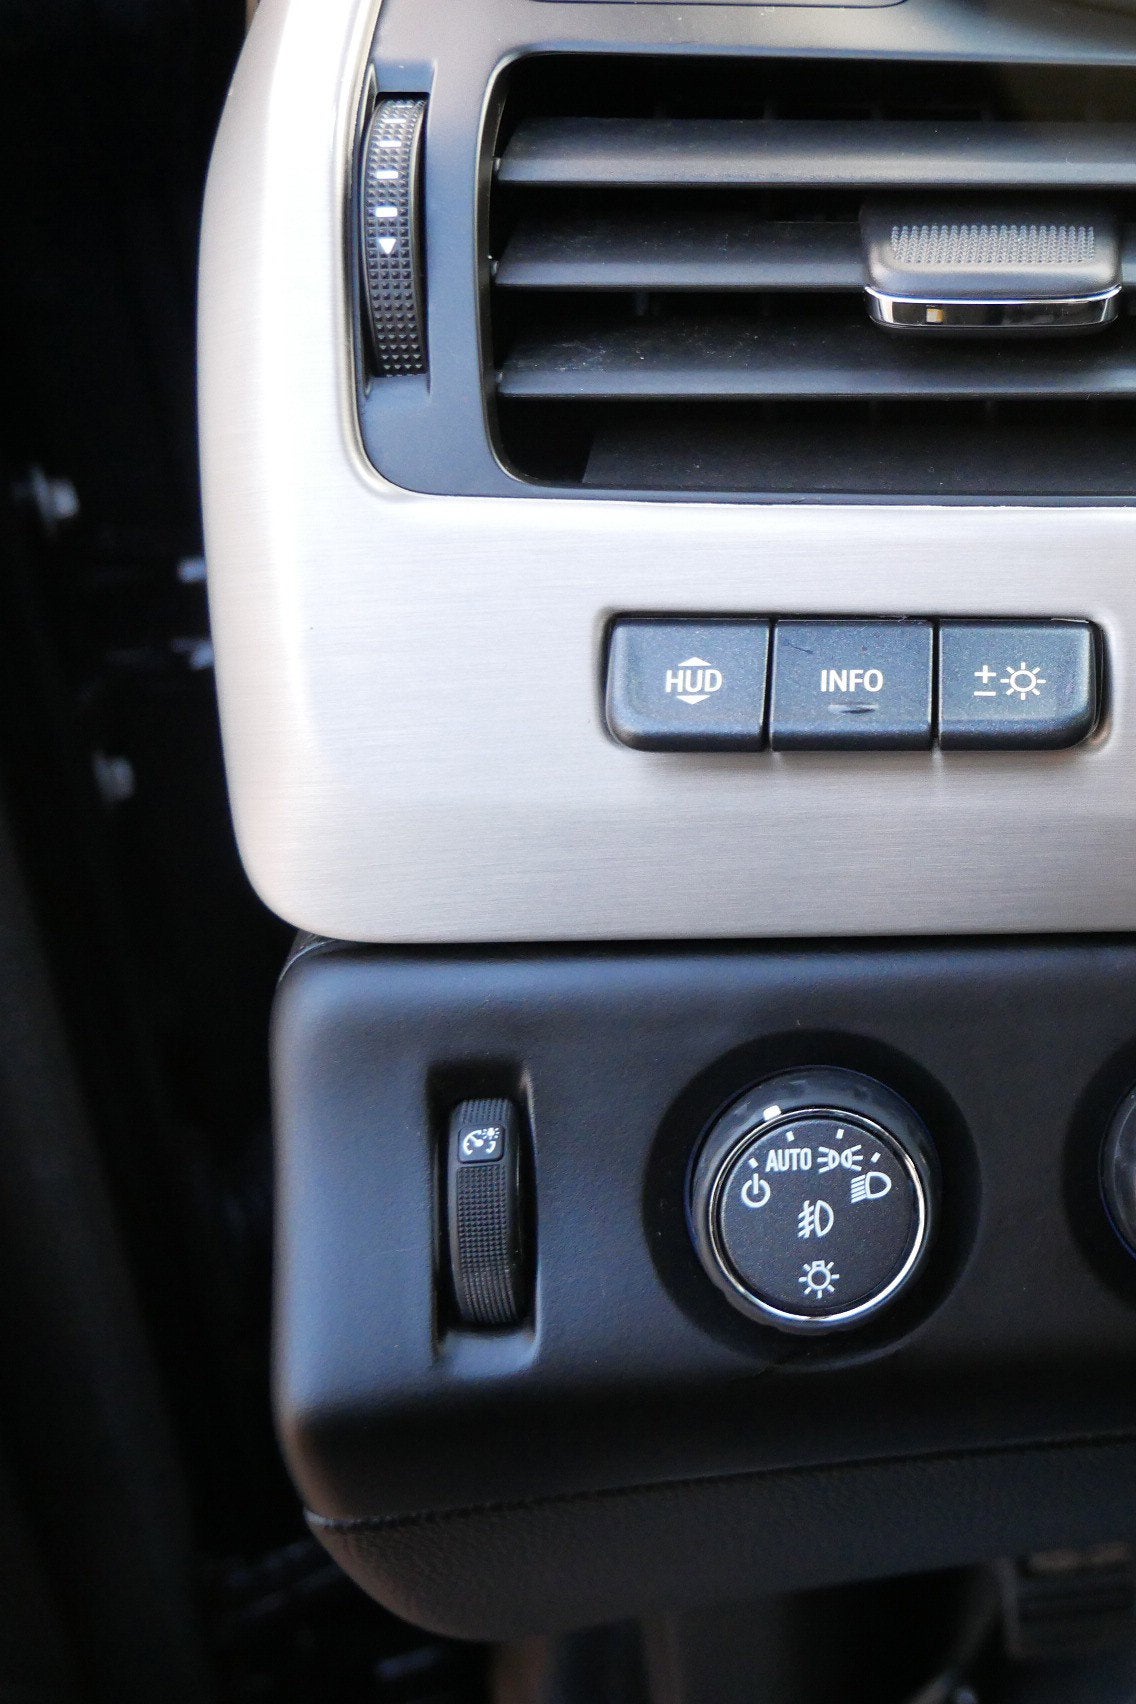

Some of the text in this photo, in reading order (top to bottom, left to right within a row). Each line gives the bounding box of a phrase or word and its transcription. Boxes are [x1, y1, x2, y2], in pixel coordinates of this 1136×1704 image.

[665, 669, 722, 694] HUD
[820, 669, 884, 692] INFO
[765, 1147, 813, 1172] AUTO
